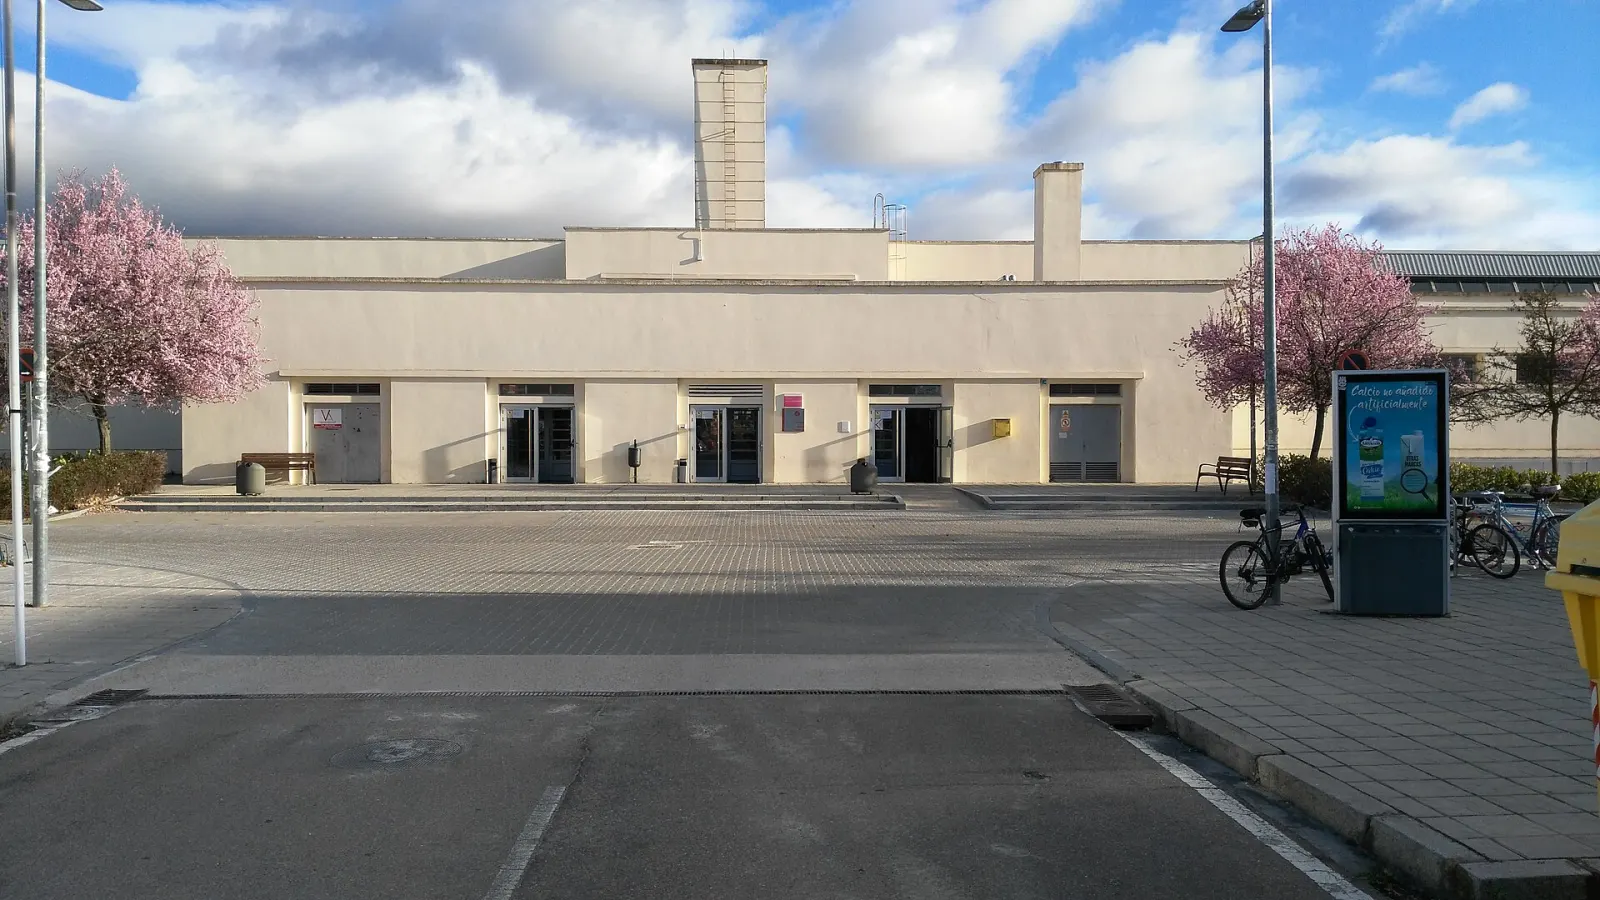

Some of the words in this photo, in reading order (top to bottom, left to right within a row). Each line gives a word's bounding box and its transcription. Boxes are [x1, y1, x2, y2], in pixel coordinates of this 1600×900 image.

[1351, 384, 1380, 397] Calcio
[1383, 389, 1393, 397] no
[1395, 384, 1434, 397] añadido
[1357, 396, 1428, 412] artificialmente
